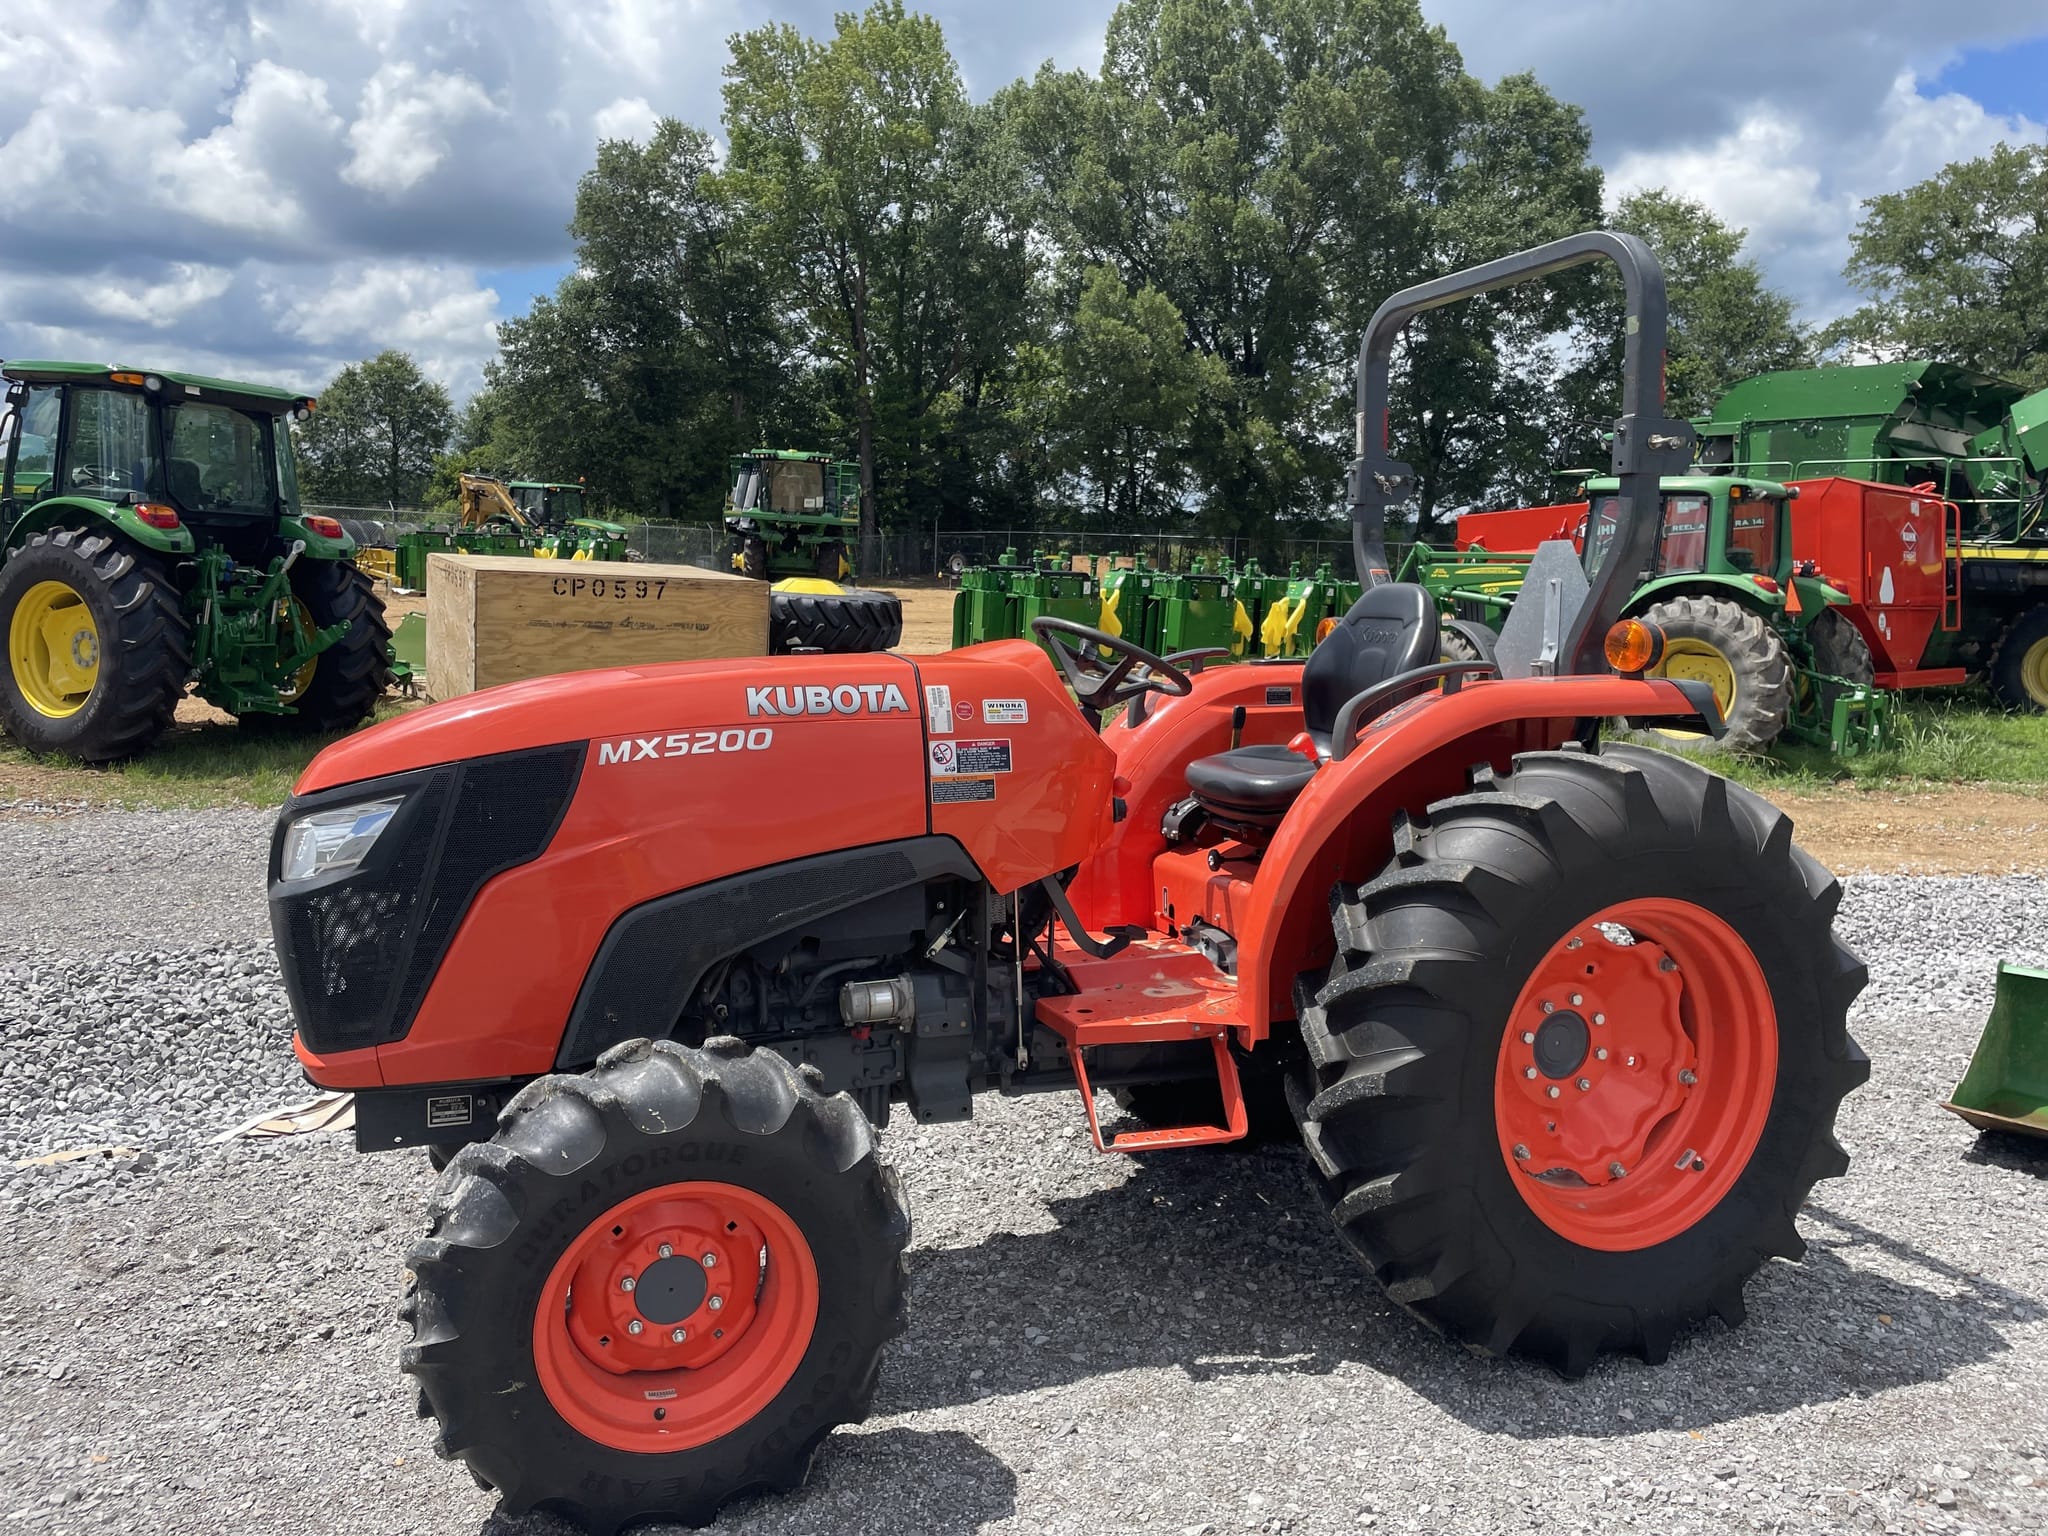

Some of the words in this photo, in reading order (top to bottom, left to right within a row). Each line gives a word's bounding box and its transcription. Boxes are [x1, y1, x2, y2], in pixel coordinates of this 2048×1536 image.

[1672, 524, 1696, 532] REEL
[746, 684, 909, 716] KUBOTA
[598, 728, 773, 766] MX5200
[515, 1140, 750, 1268] DURATORQUE
